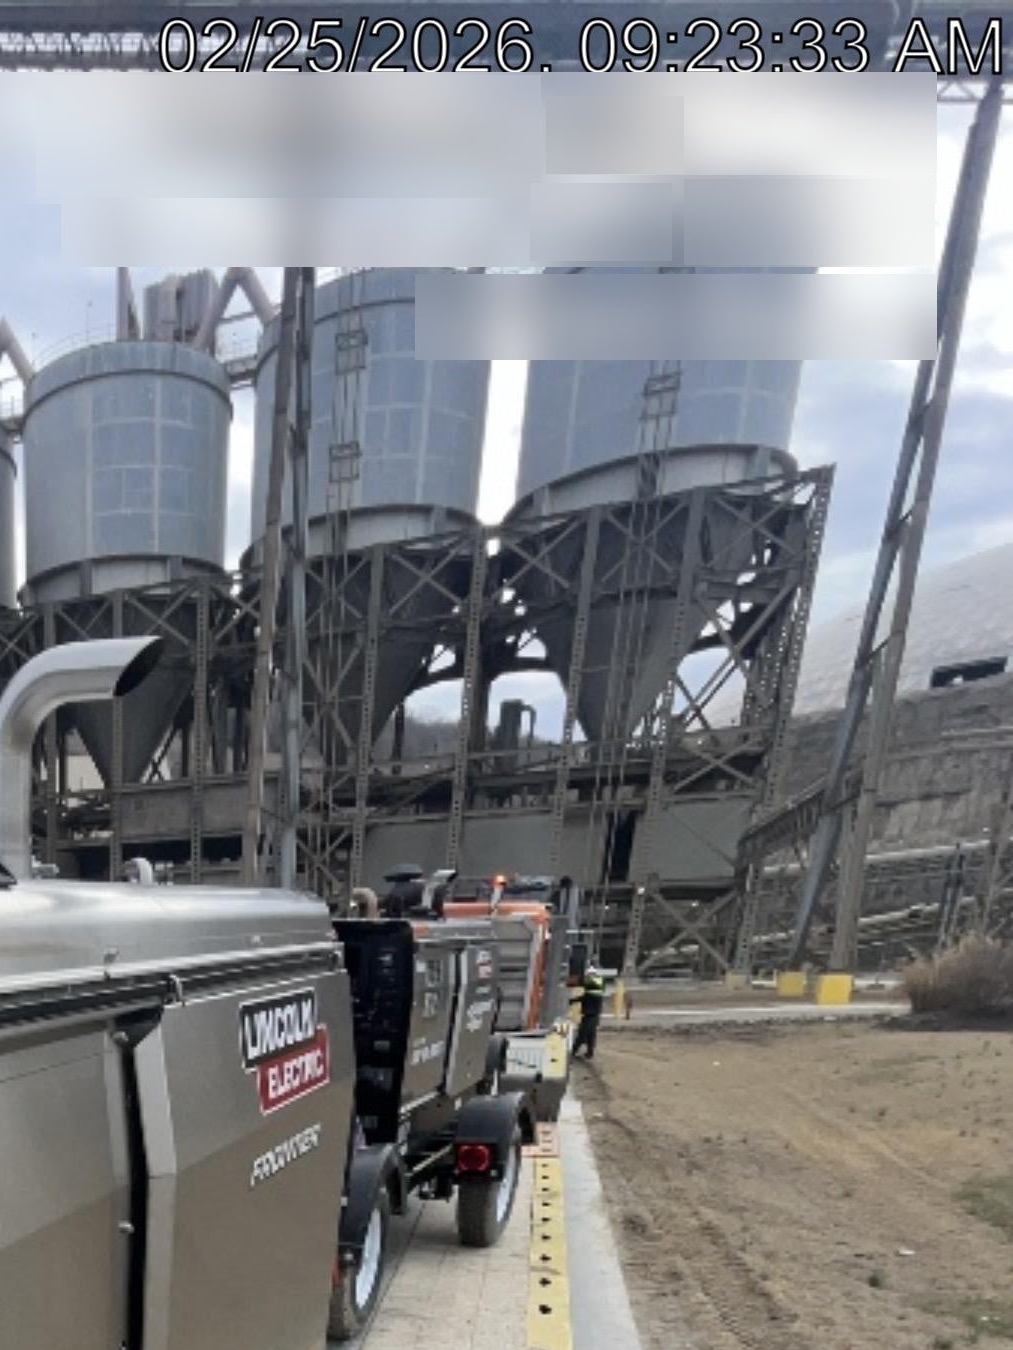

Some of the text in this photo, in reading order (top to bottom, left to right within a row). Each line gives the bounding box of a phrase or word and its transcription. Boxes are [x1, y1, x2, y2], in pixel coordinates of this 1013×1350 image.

[244, 997, 316, 1060] LINCOLN
[267, 1046, 325, 1100] ELECTRIC
[250, 1123, 322, 1187] FRONTIER
